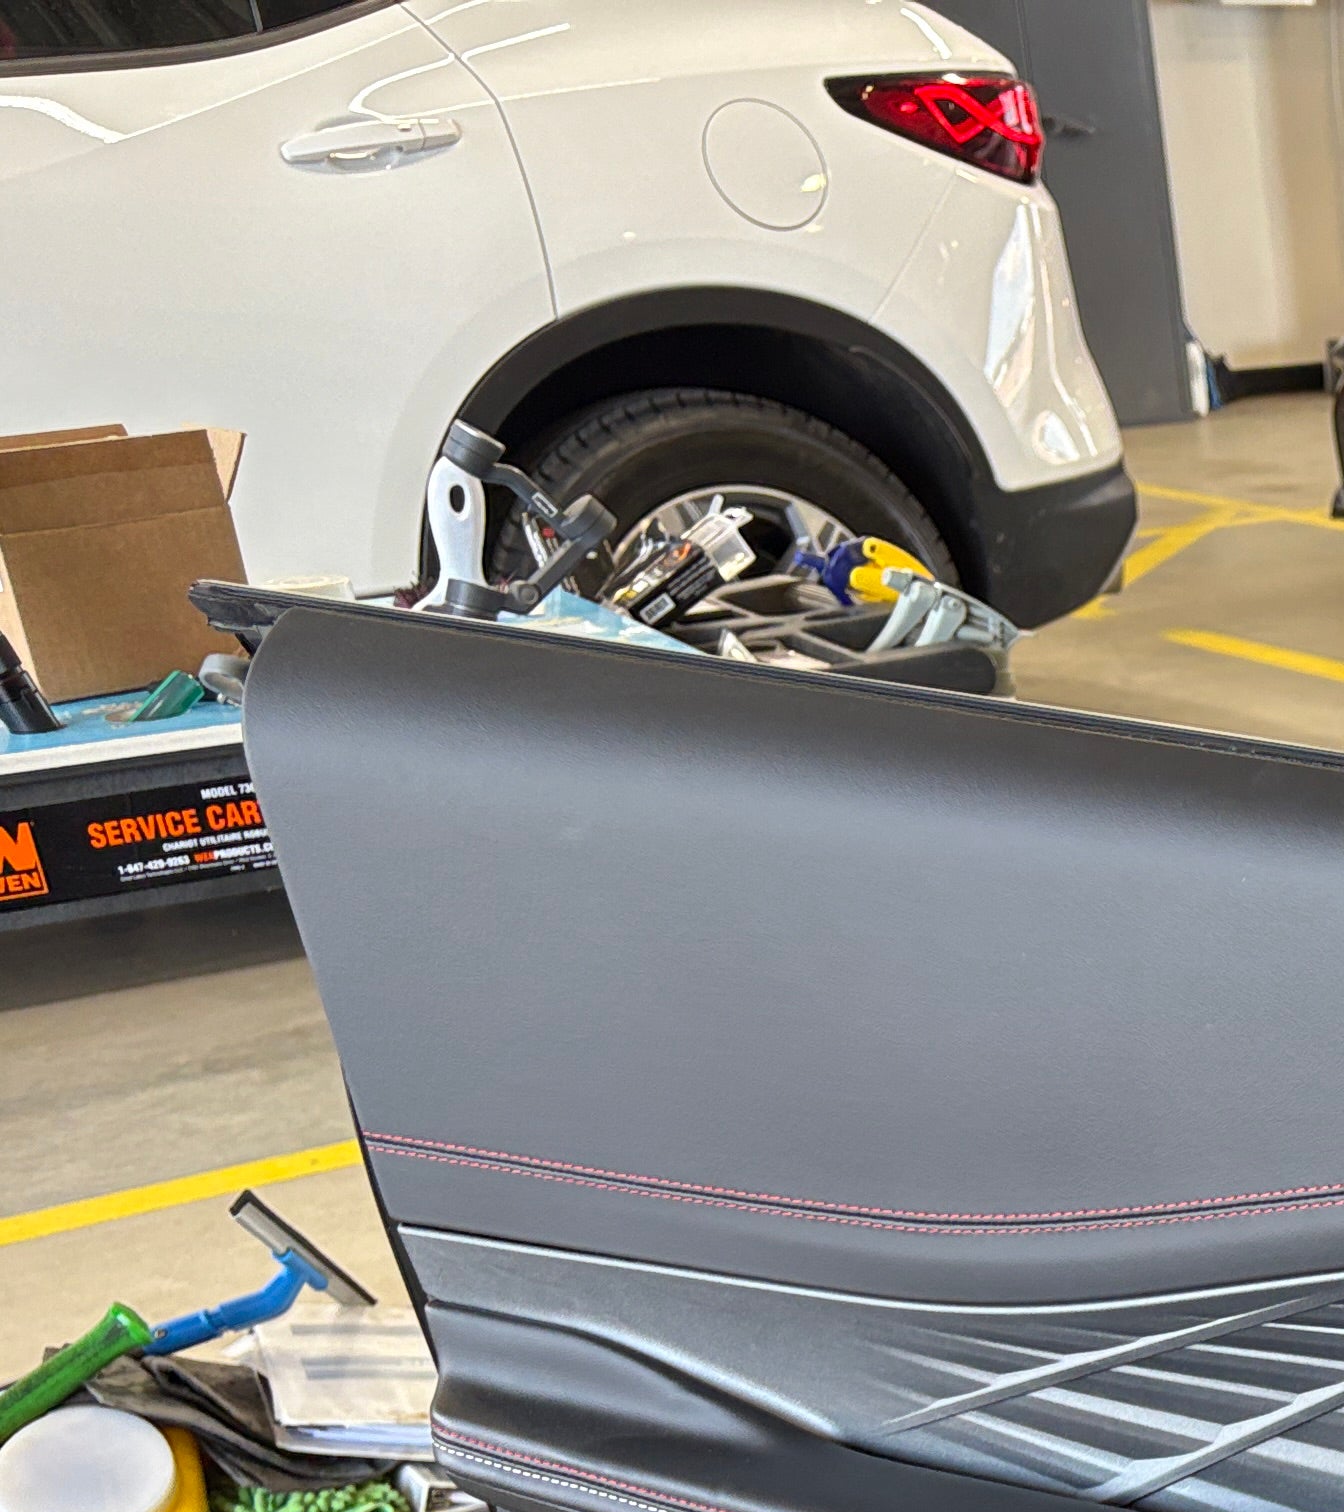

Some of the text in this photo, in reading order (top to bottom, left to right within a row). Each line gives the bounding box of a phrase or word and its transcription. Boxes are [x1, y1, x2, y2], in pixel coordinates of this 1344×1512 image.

[201, 785, 237, 800] MODEL
[88, 800, 263, 850] SERVICE CAR
